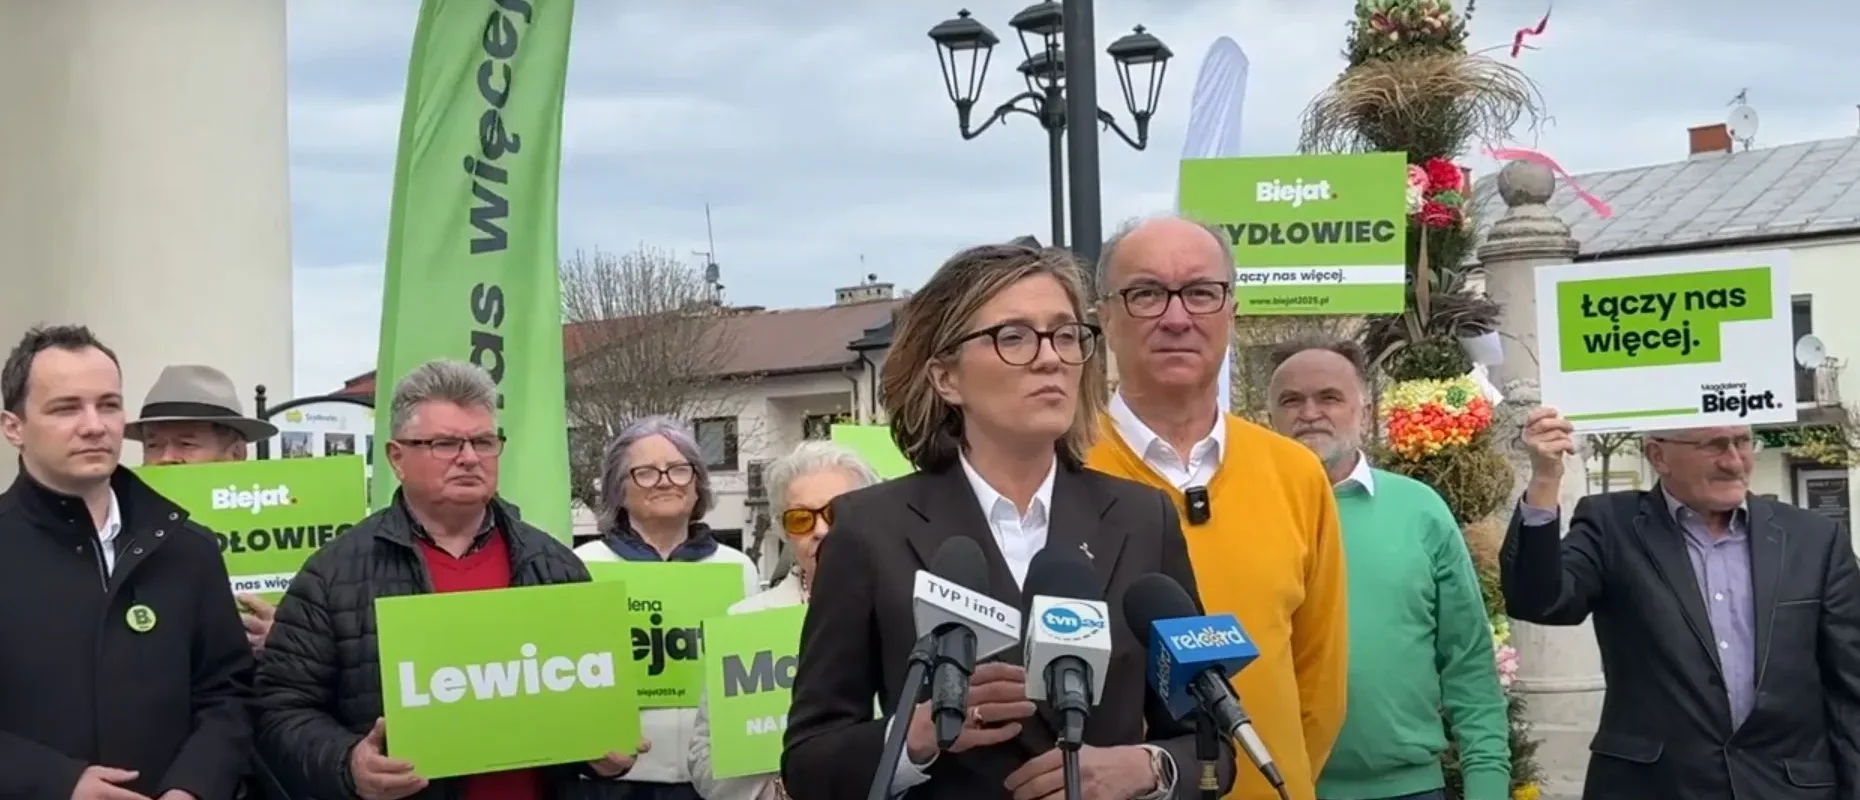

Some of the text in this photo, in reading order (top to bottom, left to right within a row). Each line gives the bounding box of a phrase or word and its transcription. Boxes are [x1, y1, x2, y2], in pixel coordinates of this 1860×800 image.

[1219, 220, 1395, 246] YDŁOWIEC
[1272, 271, 1297, 281] nas
[1300, 269, 1346, 283] więcej.
[1249, 296, 1330, 306] www.biejat2025.pl
[1581, 287, 1746, 322] Łączy nas
[1583, 321, 1700, 357] więcej.
[470, 283, 505, 434] as
[1701, 383, 1747, 391] Magdalena
[1702, 389, 1783, 418] Biejat.
[235, 579, 260, 591] nas
[927, 579, 962, 602] TVP
[398, 642, 616, 707] Lewica
[746, 715, 778, 736] NA
